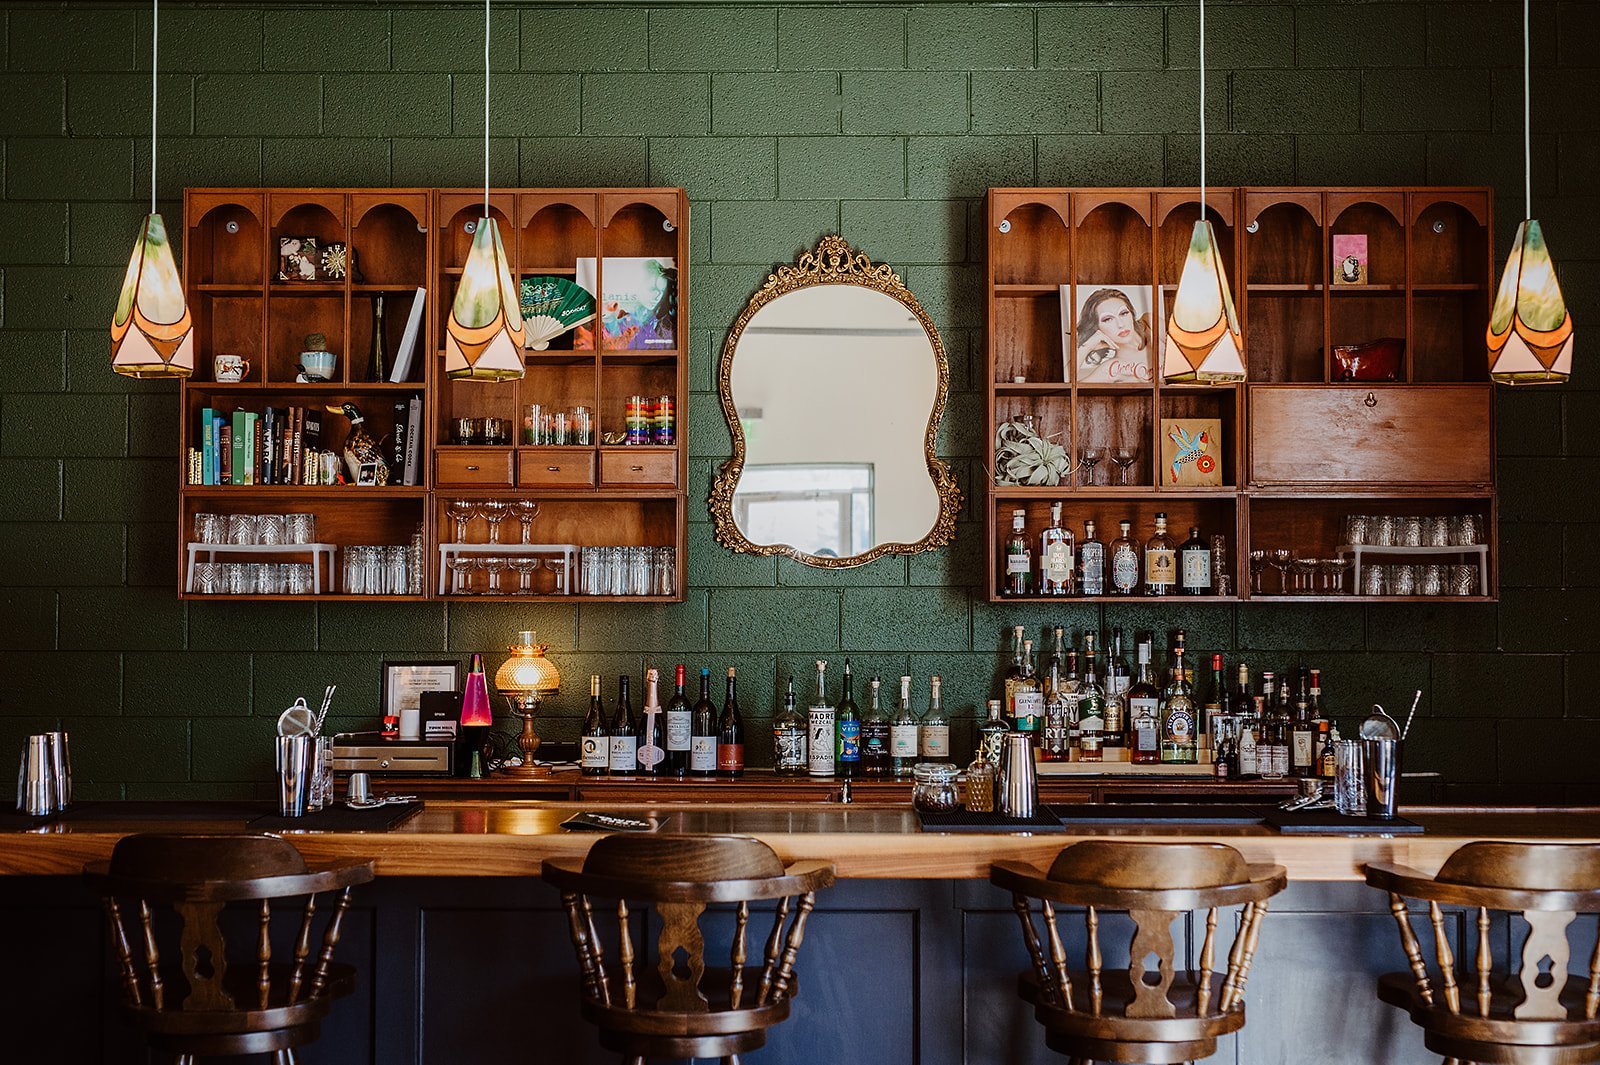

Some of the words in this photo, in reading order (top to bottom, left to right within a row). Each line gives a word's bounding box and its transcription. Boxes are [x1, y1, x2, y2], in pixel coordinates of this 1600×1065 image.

[602, 292, 637, 301] lanis
[262, 429, 270, 464] AMARO
[1045, 728, 1067, 738] RYE
